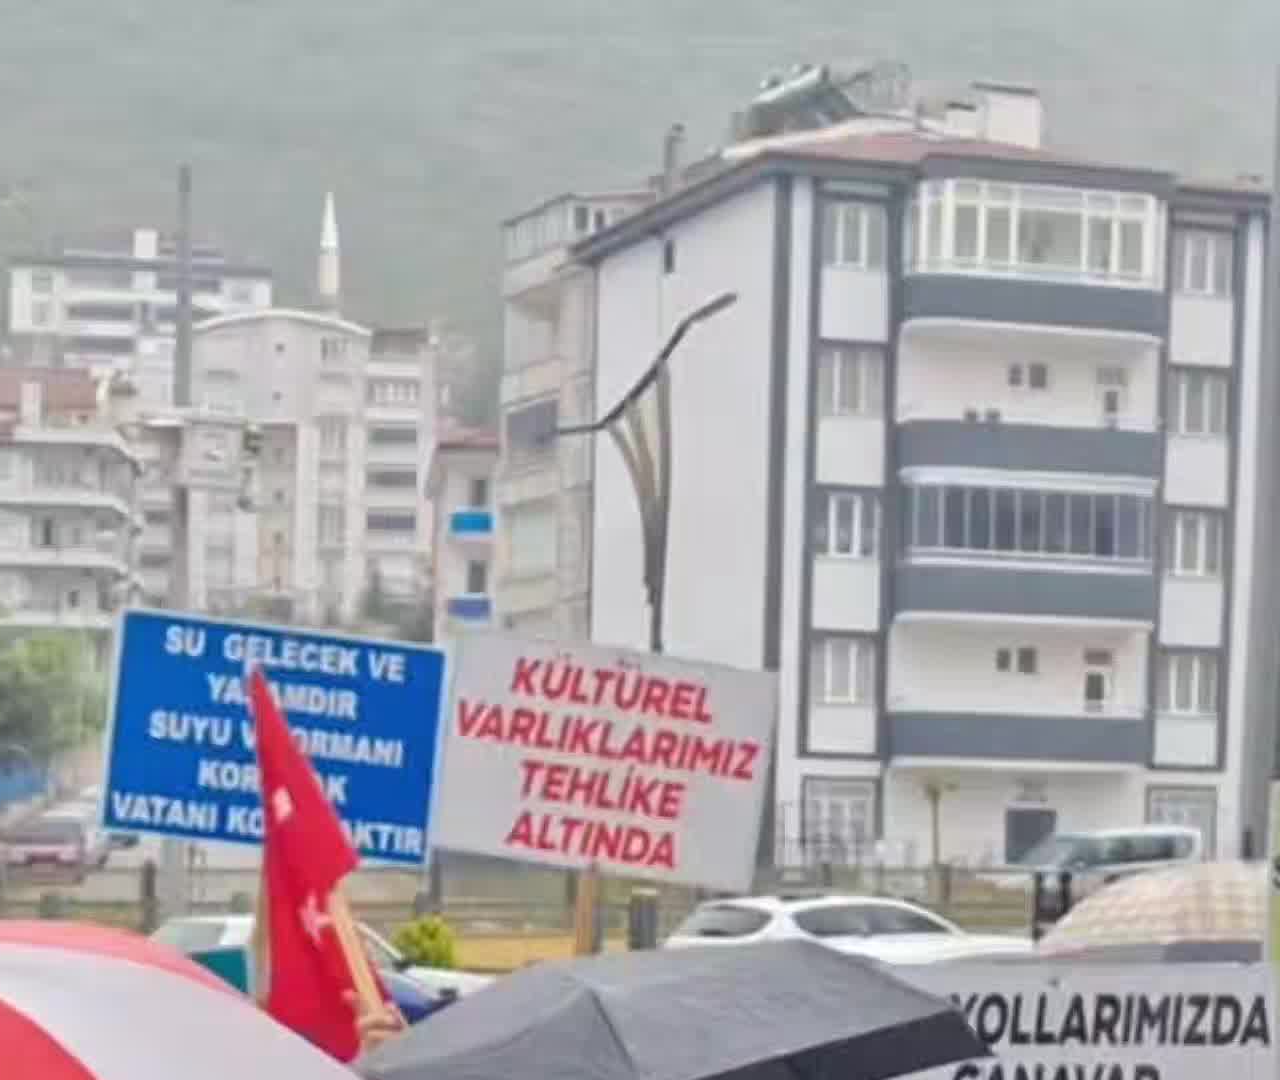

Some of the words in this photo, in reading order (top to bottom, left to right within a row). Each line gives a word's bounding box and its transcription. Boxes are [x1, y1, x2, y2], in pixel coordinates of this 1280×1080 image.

[165, 625, 206, 657] SU
[223, 633, 360, 676] GELECEK
[367, 651, 405, 683] VE
[207, 672, 358, 719] YAAMDIR
[510, 651, 713, 725] KÜLTÜREL
[149, 710, 232, 746] SUYU
[456, 699, 760, 780] VARLIKLARIMIZ
[111, 791, 217, 832] VATANI
[520, 759, 685, 819] TEHLİKE
[505, 810, 676, 869] ALTINDA
